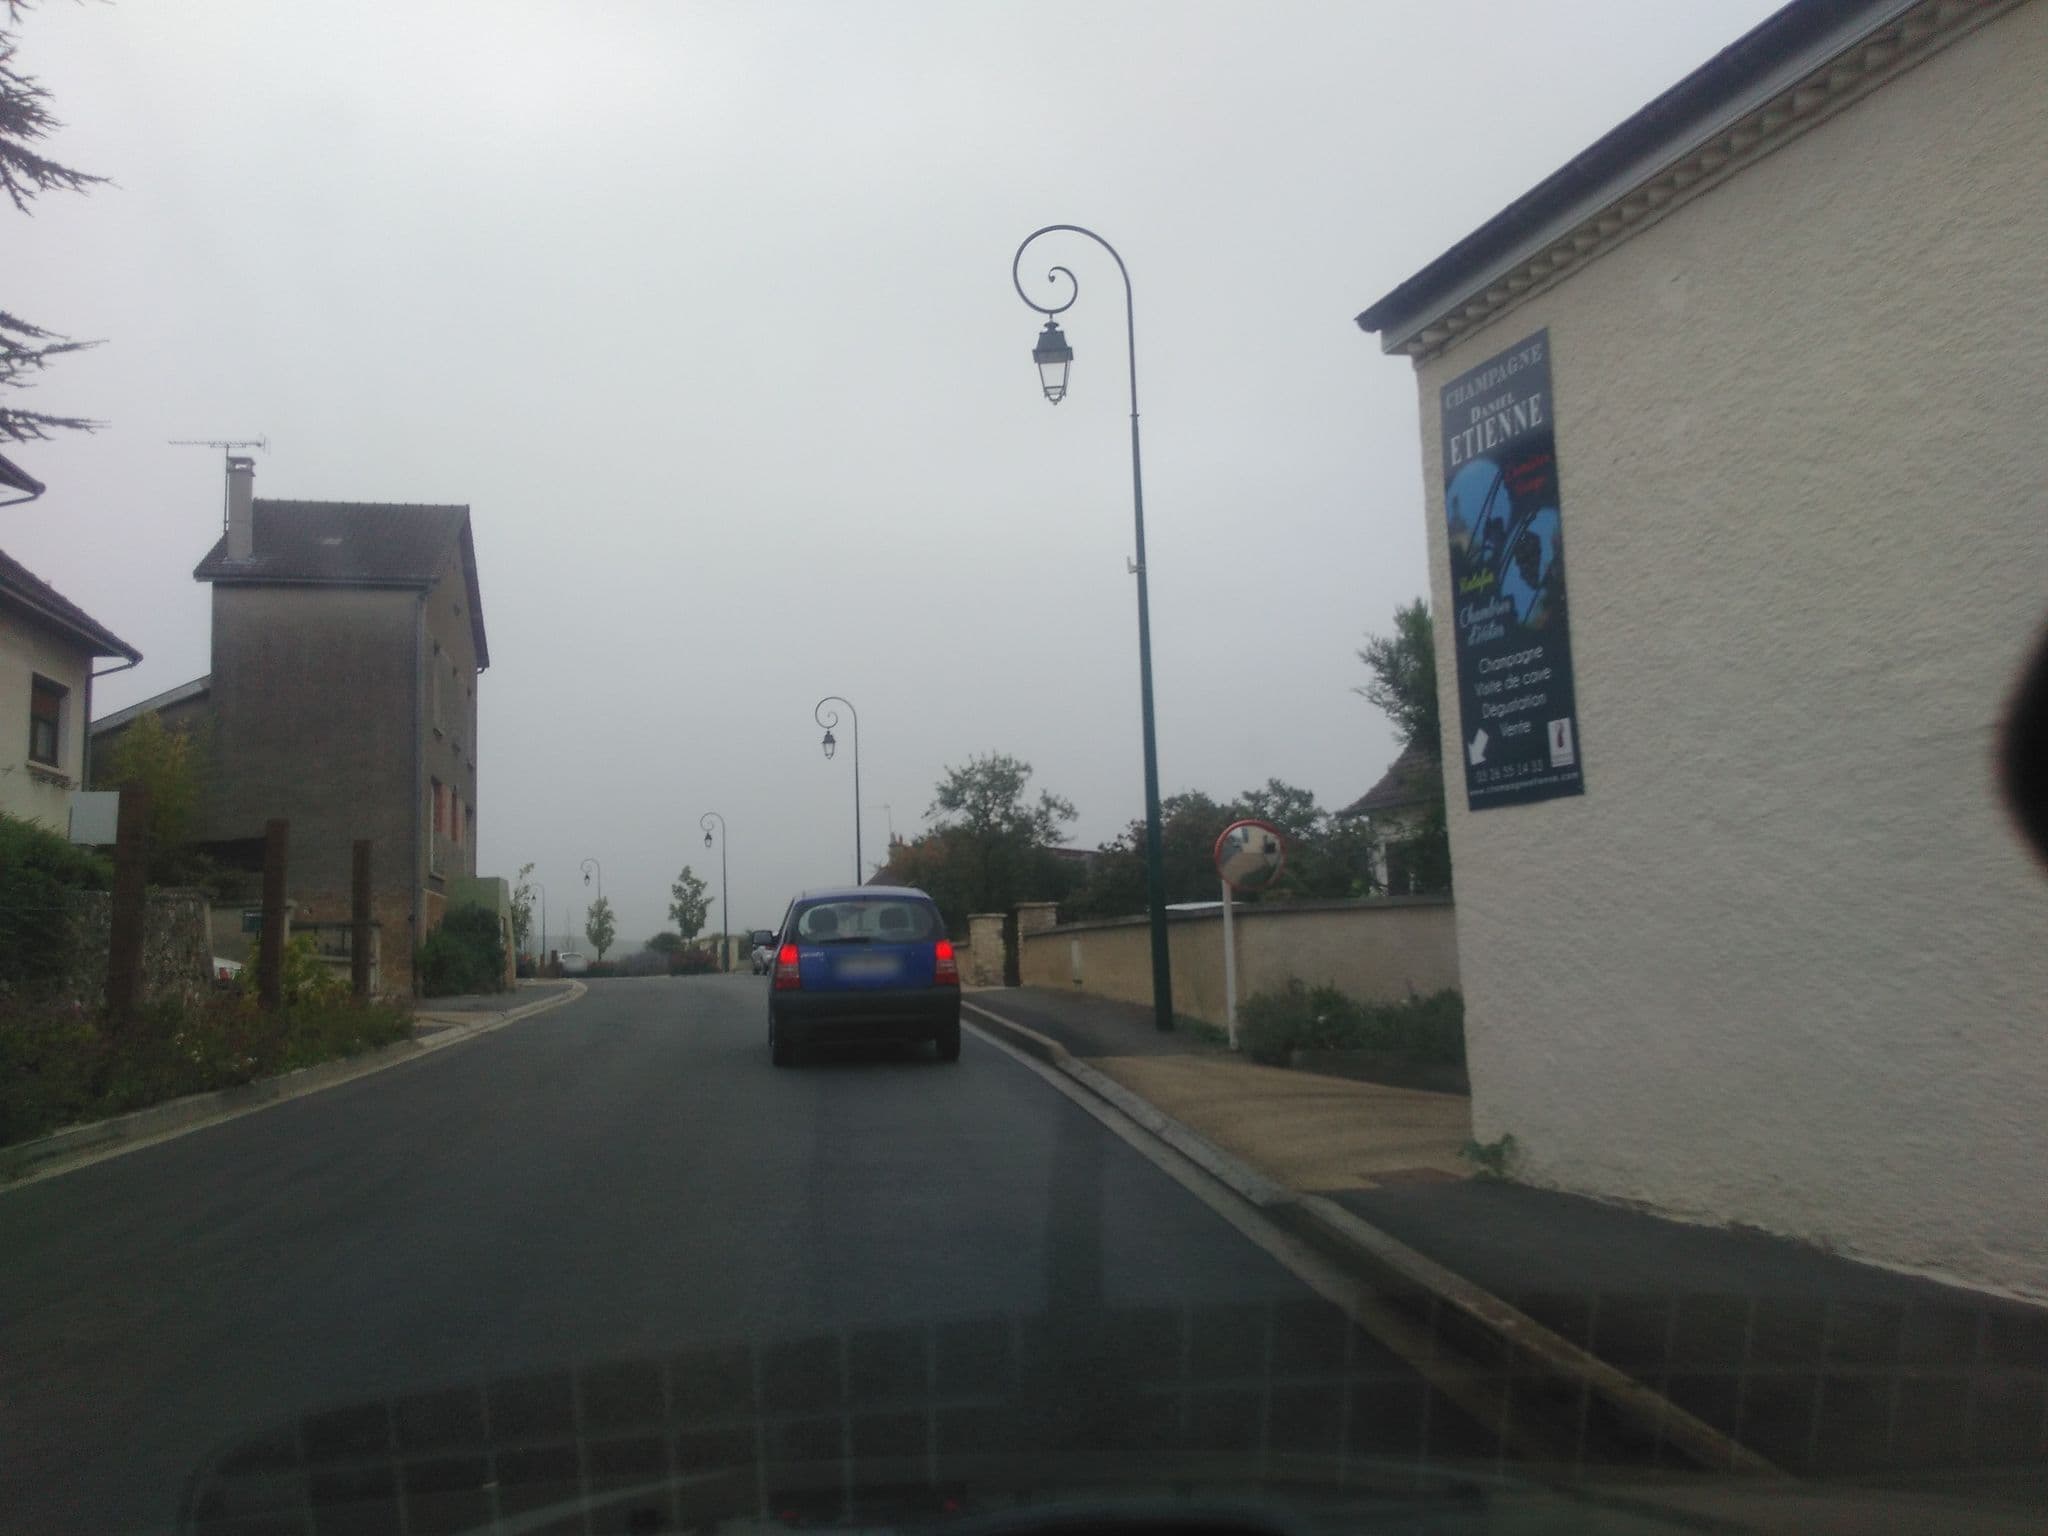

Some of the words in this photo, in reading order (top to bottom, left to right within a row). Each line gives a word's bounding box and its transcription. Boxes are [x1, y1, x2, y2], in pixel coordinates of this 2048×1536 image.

[1446, 343, 1543, 409] CHAMPAGNE
[1450, 393, 1543, 466] ETIENNE
[1479, 646, 1544, 674] Champagne
[1505, 674, 1520, 690] de
[1523, 667, 1552, 685] cave
[1499, 720, 1531, 736] Vente
